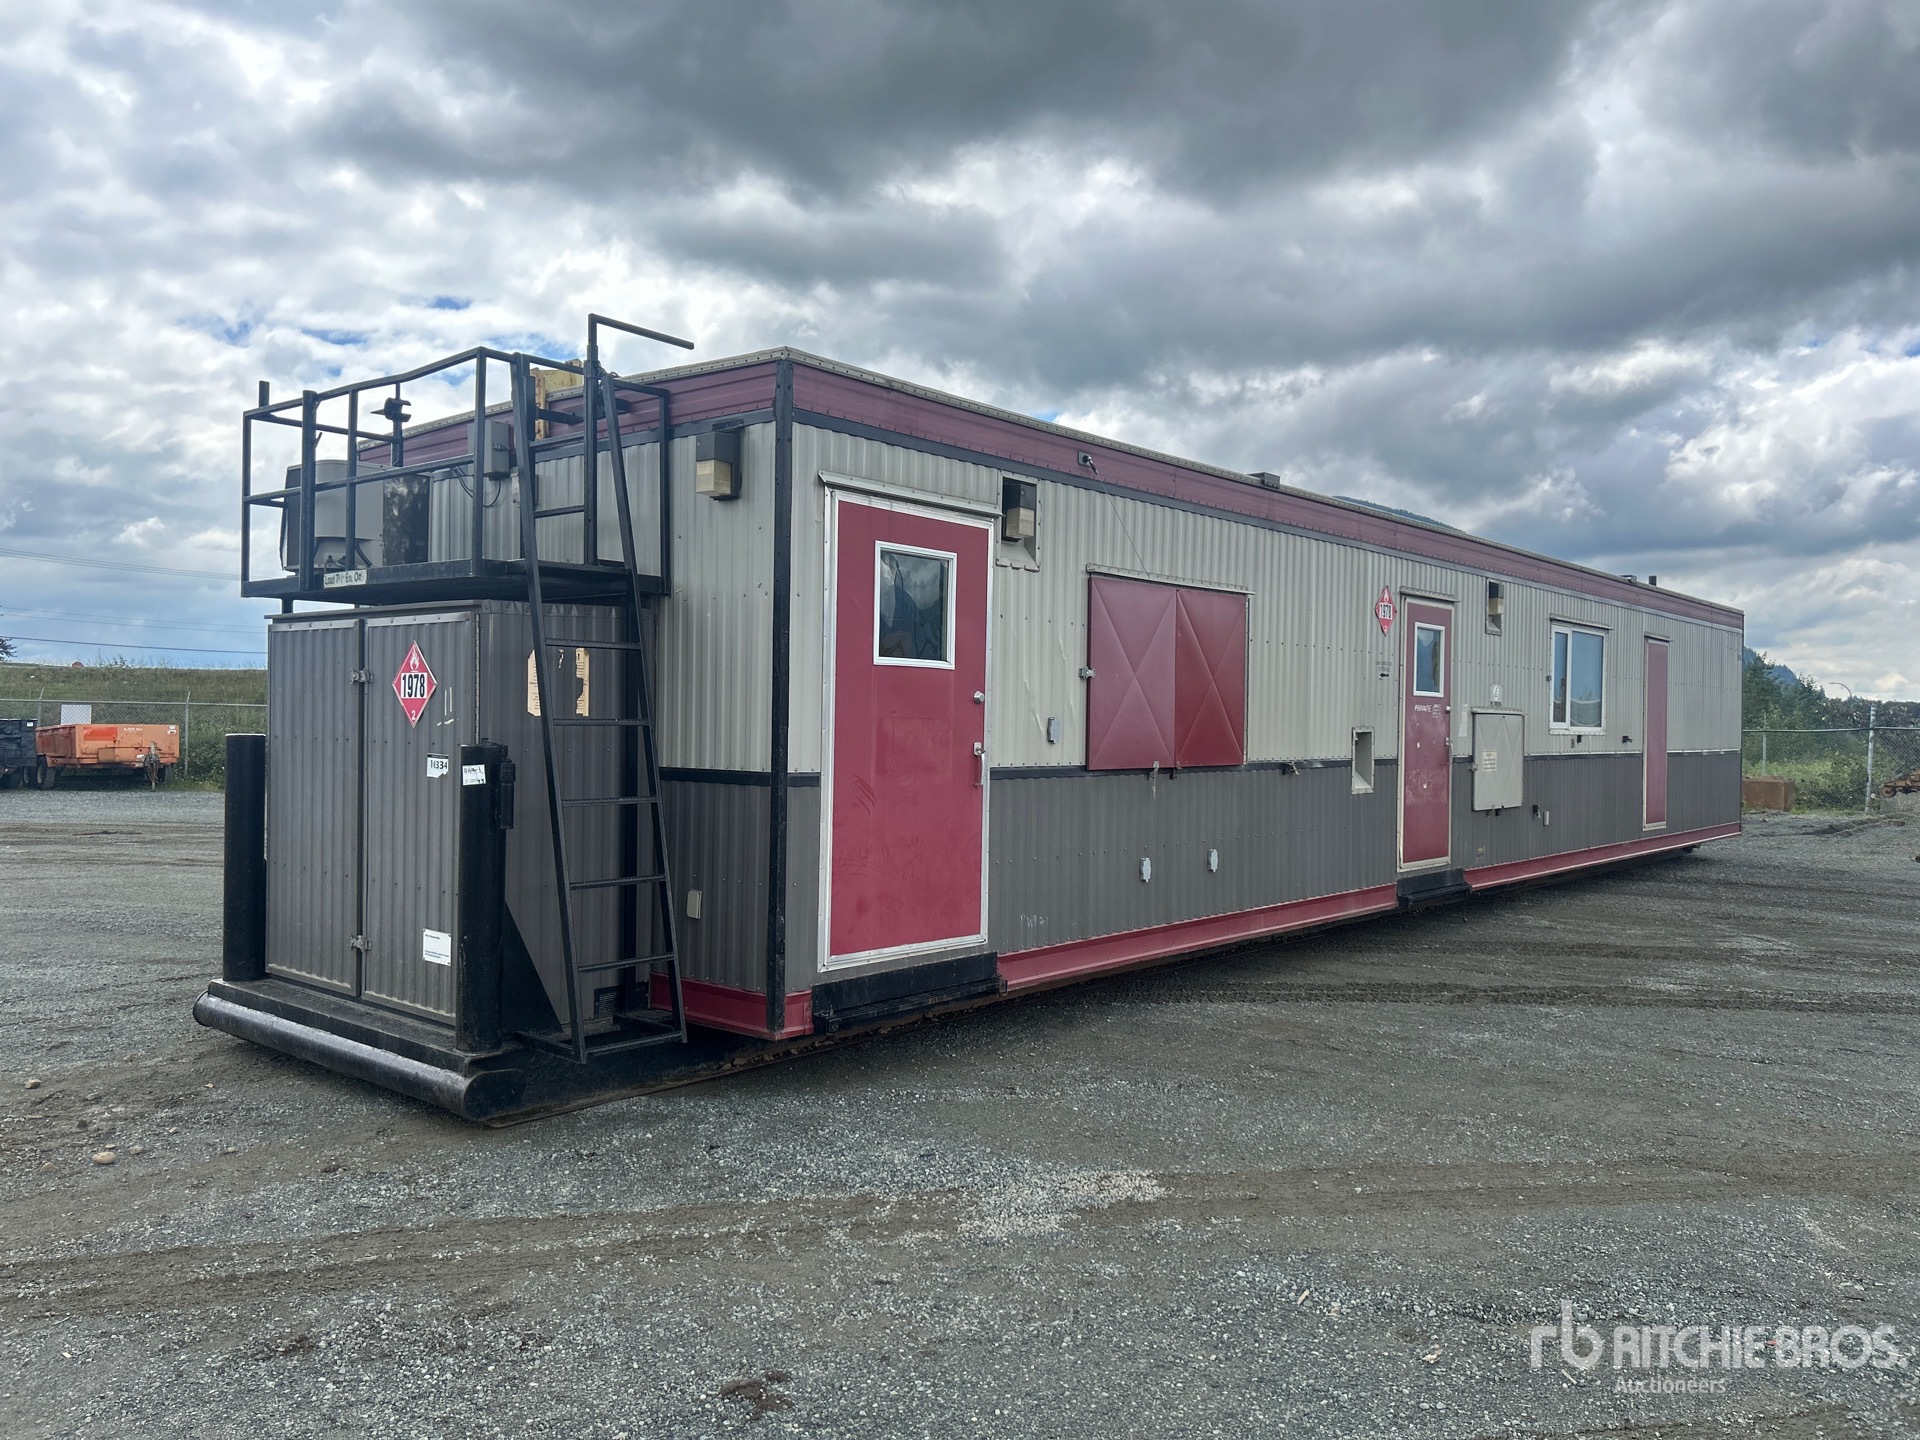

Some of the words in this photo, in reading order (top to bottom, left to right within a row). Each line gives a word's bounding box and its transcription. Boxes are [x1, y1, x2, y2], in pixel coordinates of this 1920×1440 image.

[402, 673, 425, 698] 1978
[1413, 703, 1432, 713] PRIVATE
[411, 709, 416, 720] 2
